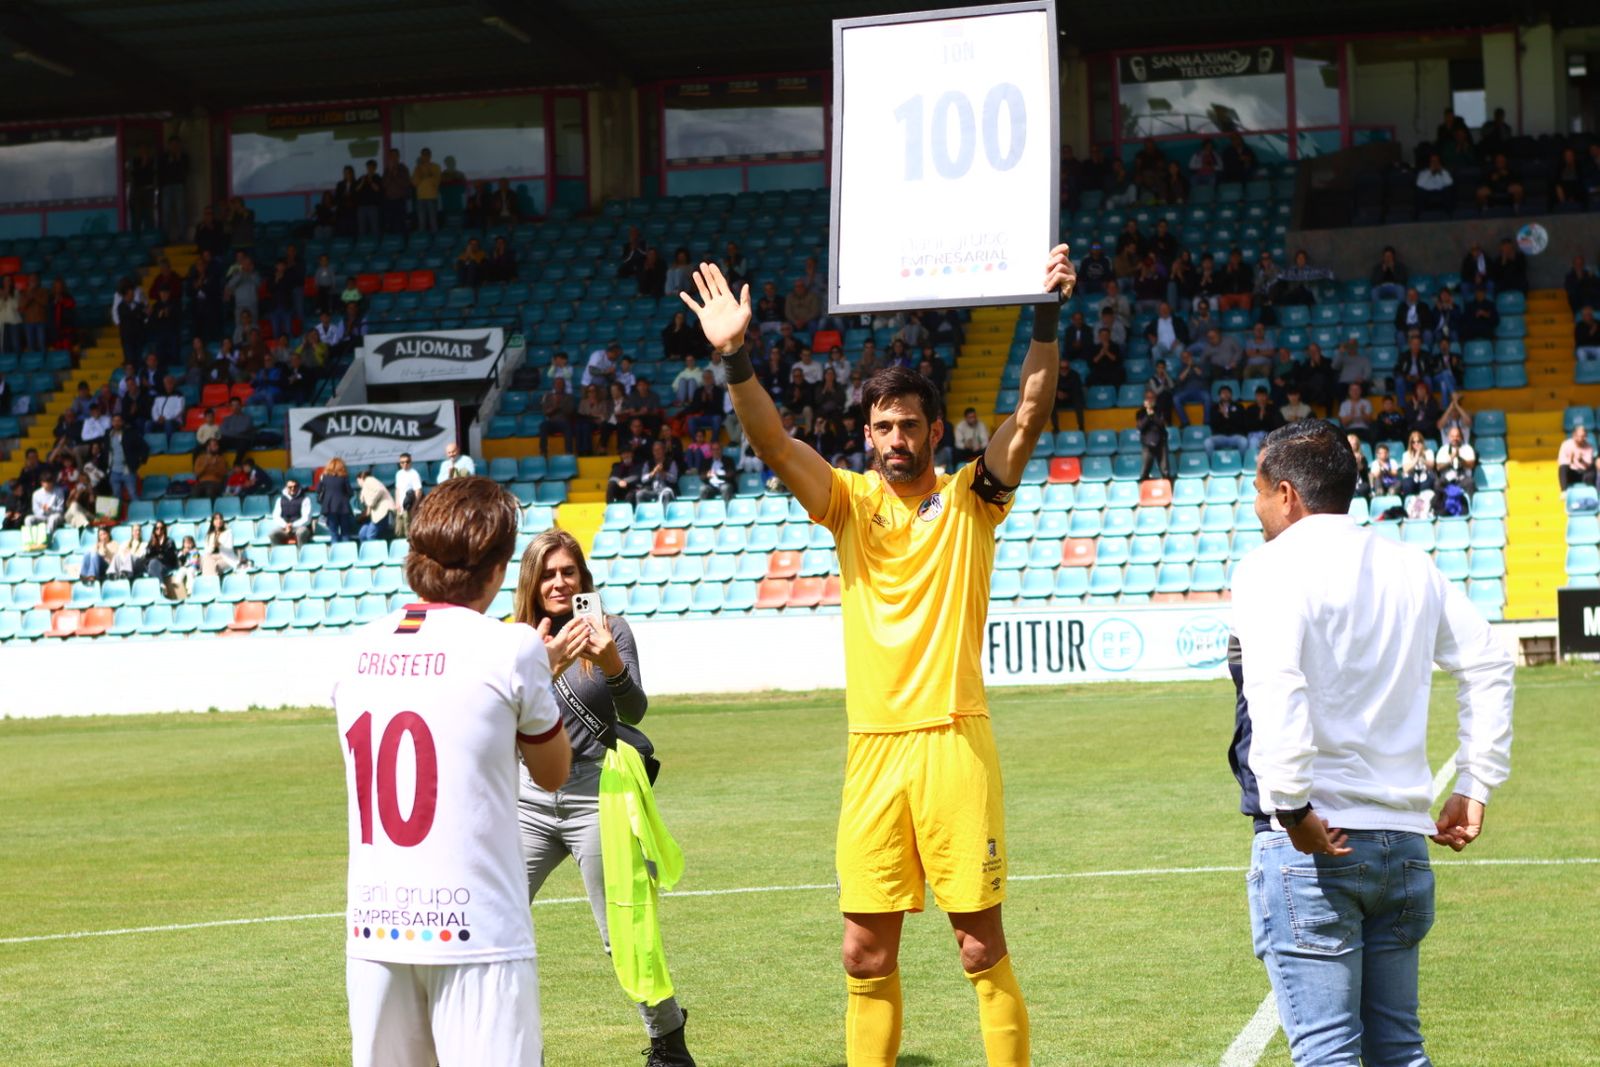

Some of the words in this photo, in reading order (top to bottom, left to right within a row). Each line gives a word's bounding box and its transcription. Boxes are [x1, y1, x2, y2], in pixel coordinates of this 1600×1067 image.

[1152, 50, 1241, 69] SANMAXIMO
[1180, 64, 1236, 78] TELECOM
[893, 82, 1027, 181] 100
[395, 339, 474, 359] ALJOMAR
[325, 414, 420, 437] ALJOMAR
[988, 619, 1086, 675] FUTUR
[358, 652, 446, 677] CRISTETO
[569, 697, 586, 715] KORS
[345, 710, 439, 848] 10
[395, 886, 471, 910] grupo
[353, 907, 471, 927] EMPRESARIAL
